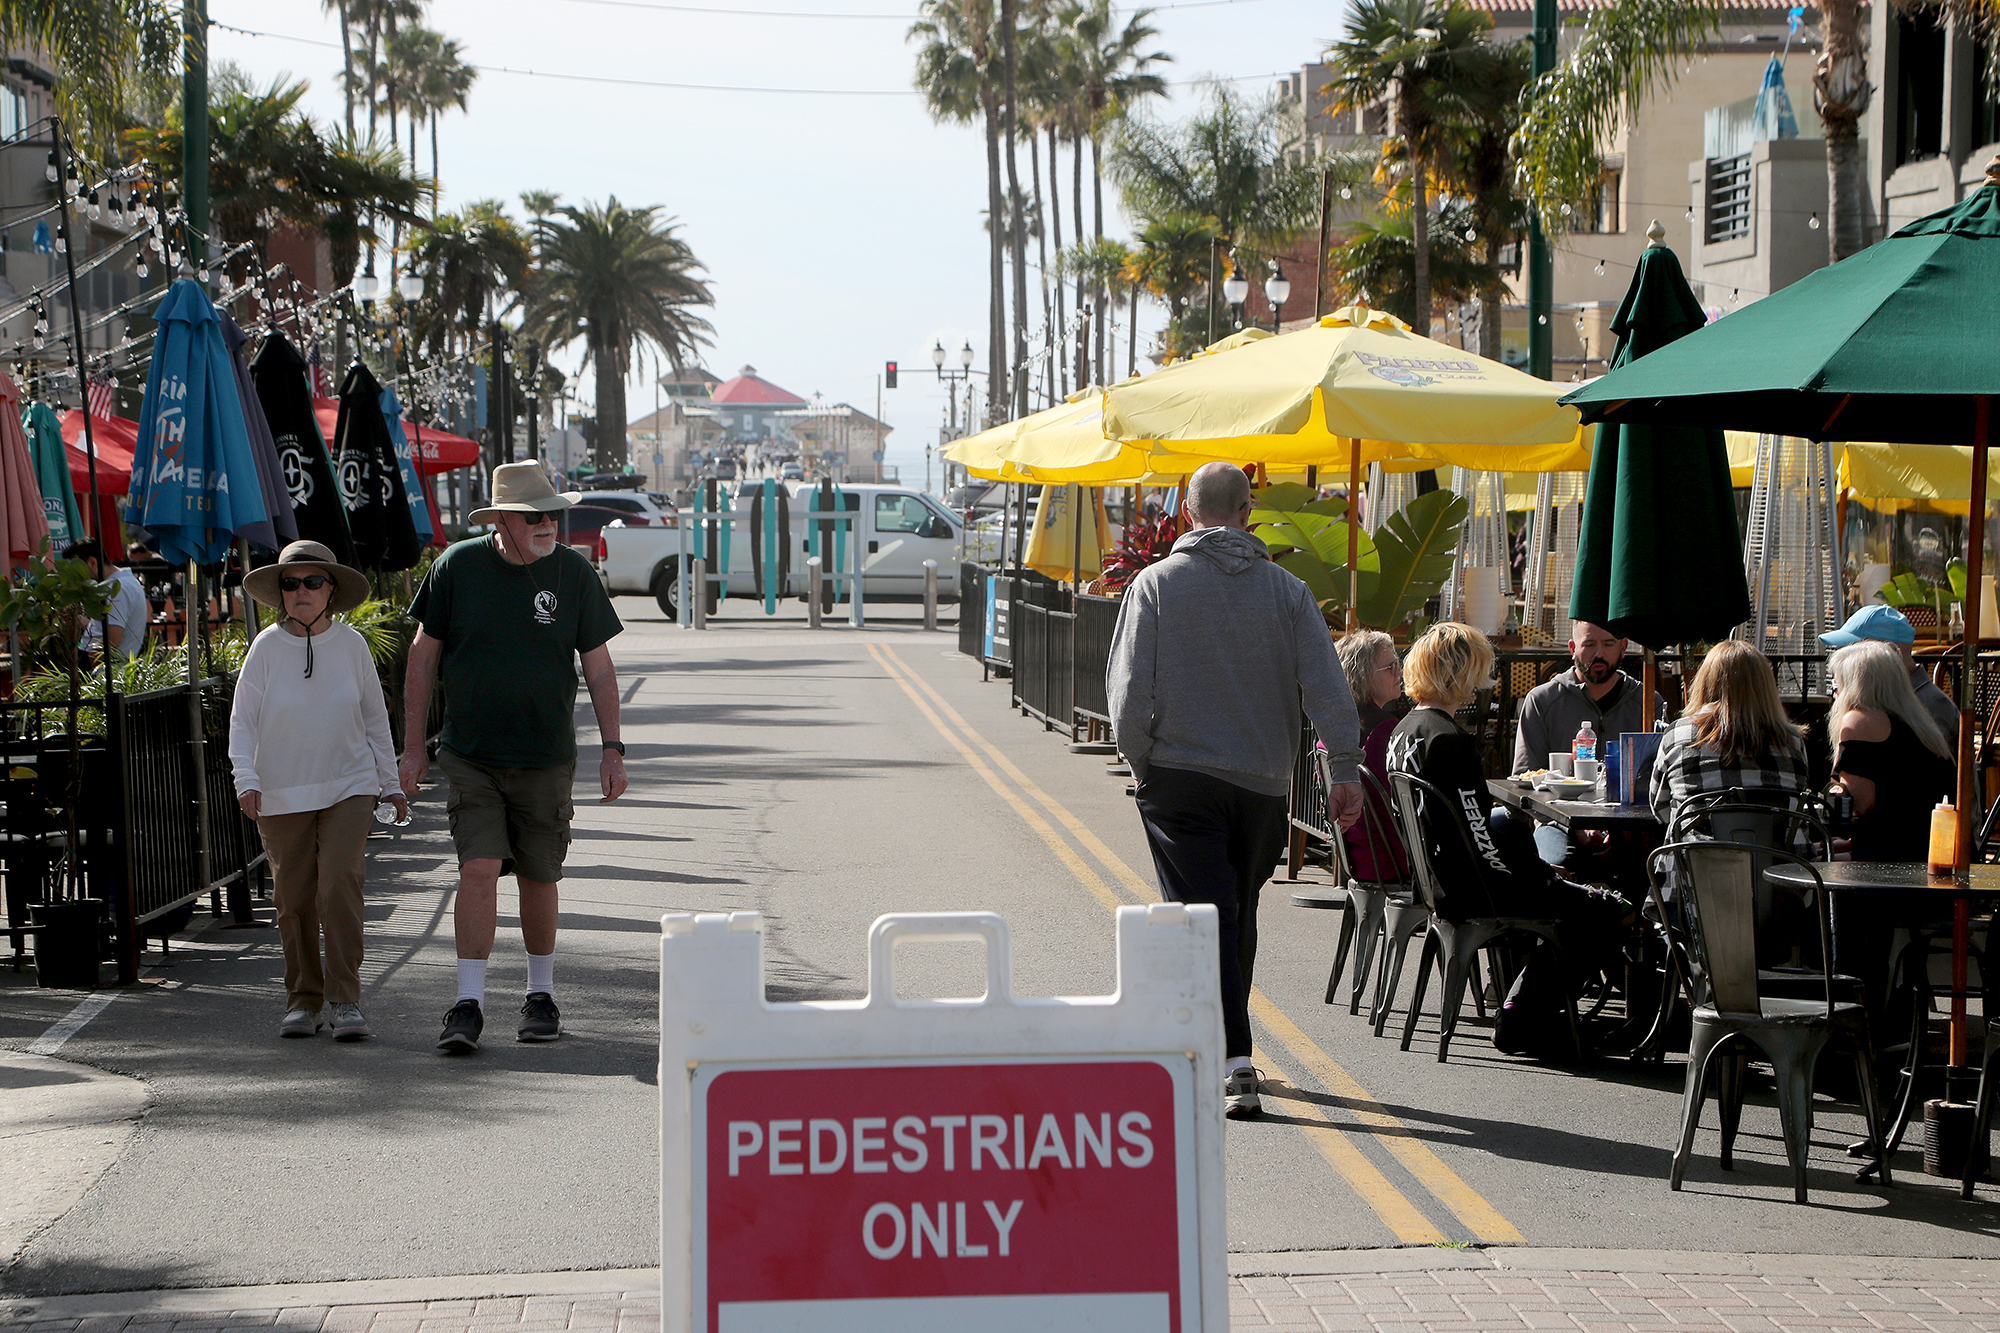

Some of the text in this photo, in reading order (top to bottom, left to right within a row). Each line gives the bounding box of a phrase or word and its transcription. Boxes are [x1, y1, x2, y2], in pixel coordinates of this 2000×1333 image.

[1353, 350, 1480, 371] PACIFICO
[728, 1111, 1154, 1176] PEDESTRIANS
[862, 1199, 1024, 1260] ONLY
